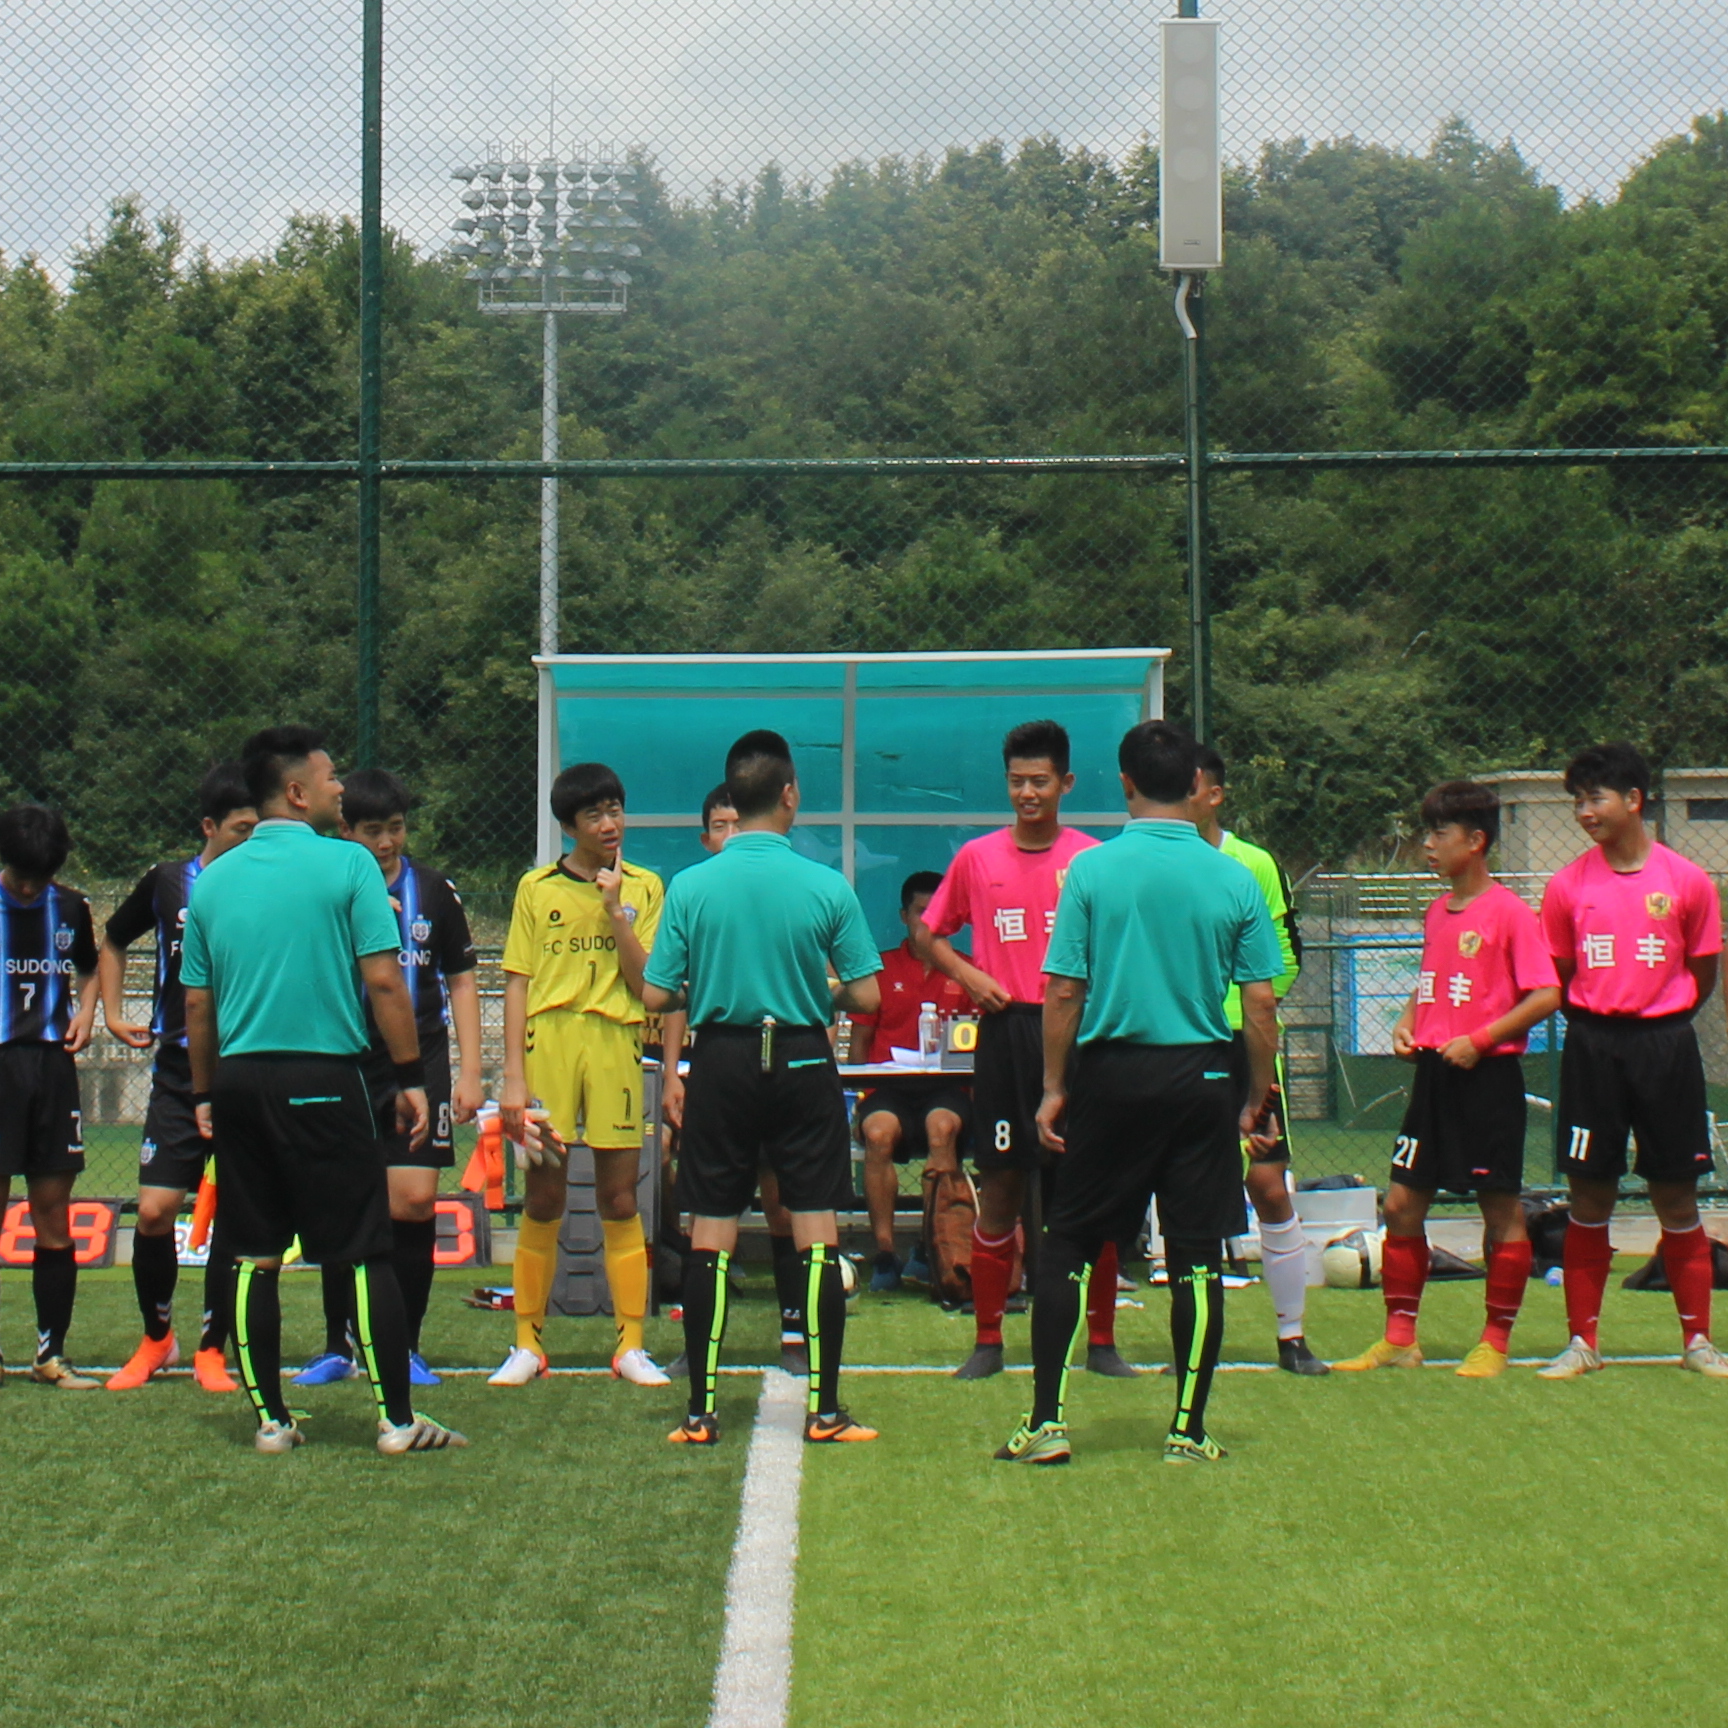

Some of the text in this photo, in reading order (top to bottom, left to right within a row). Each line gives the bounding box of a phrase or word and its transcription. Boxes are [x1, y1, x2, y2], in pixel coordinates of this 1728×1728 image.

[397, 949, 432, 966] ONG
[543, 936, 616, 957] FC SUDO
[1583, 933, 1666, 969] 恒丰
[6, 958, 73, 974] SUDONG
[19, 983, 36, 1011] 7
[953, 1021, 978, 1051] 0
[437, 1102, 450, 1137] 8
[623, 1087, 631, 1120] 1
[995, 1119, 1011, 1151] 8
[1569, 1125, 1592, 1161] 11
[1392, 1135, 1419, 1169] 21
